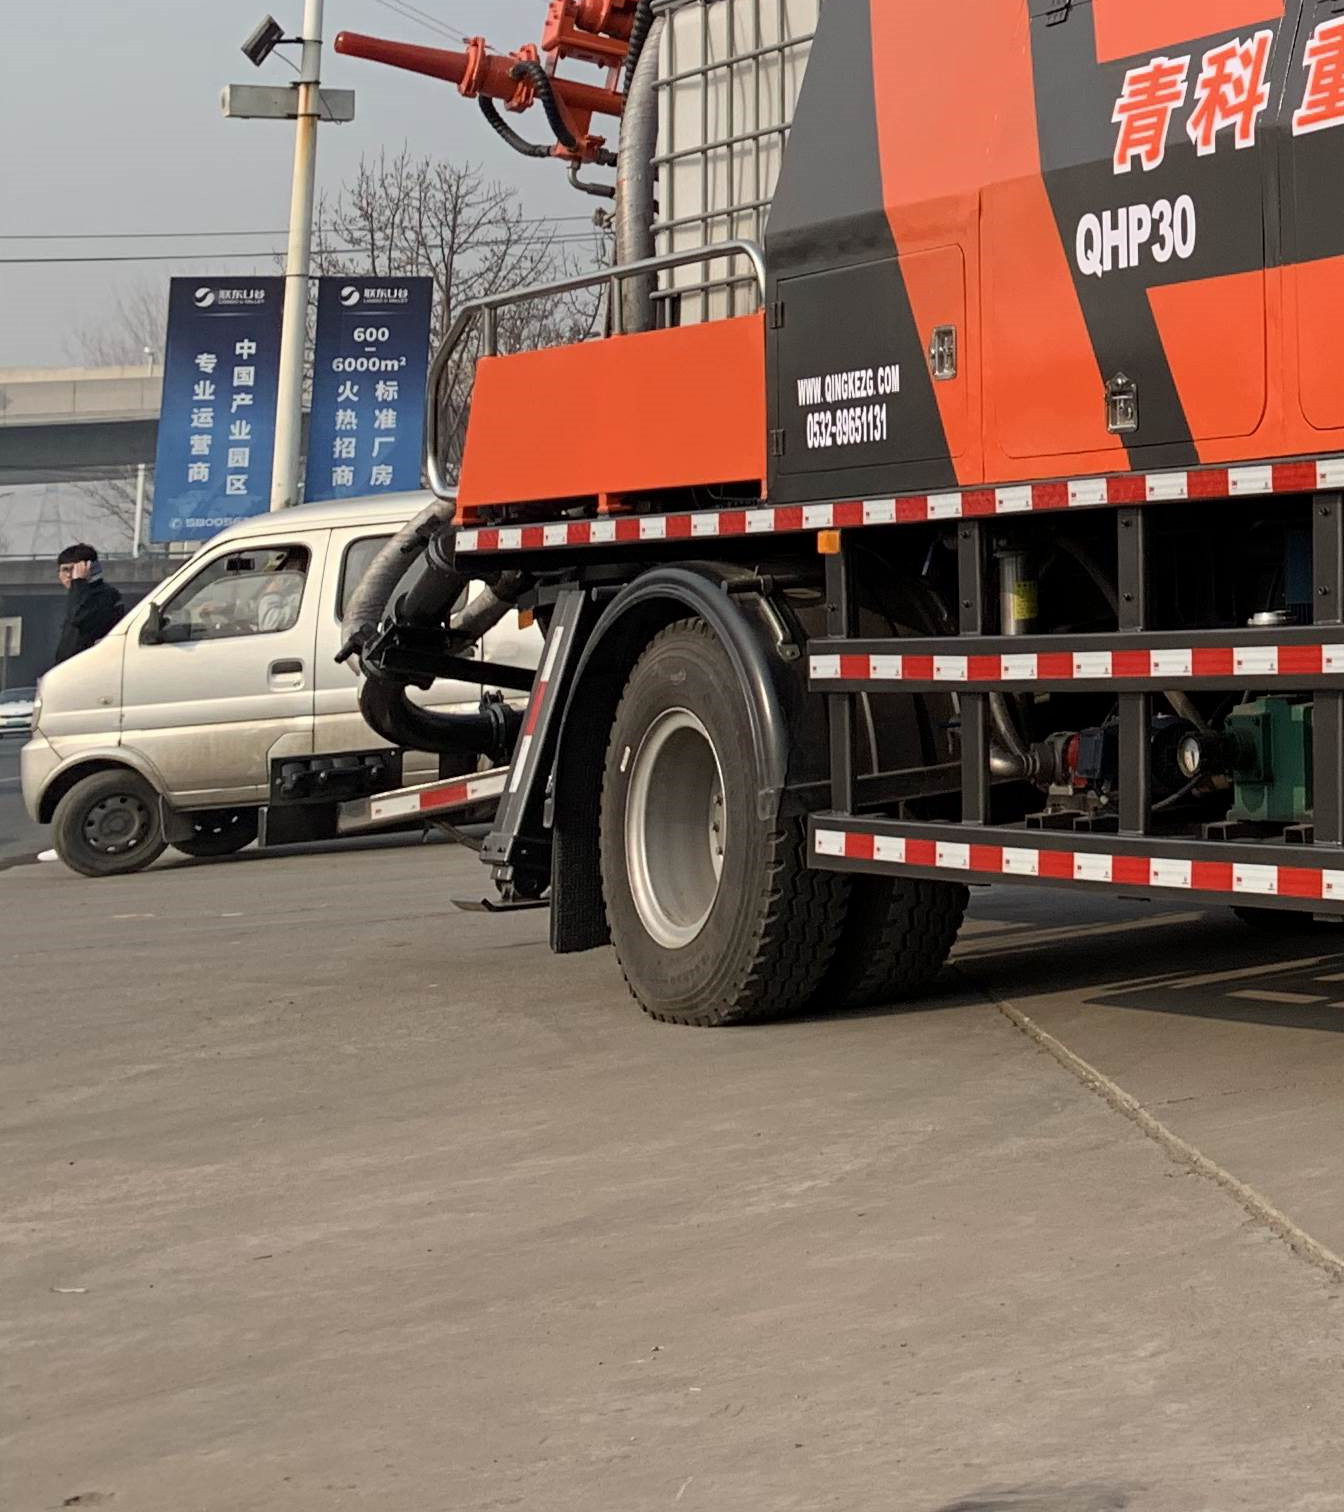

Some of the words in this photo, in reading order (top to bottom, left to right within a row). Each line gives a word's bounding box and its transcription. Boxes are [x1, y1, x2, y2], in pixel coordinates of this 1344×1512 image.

[1075, 194, 1197, 278] QHP30
[353, 327, 390, 342] 600
[187, 352, 217, 483] 专业运营商
[225, 338, 257, 495] 中国产业园区
[331, 381, 360, 486] 火热招商
[369, 380, 399, 486] 标准厂房
[806, 403, 887, 448] 0532-89651131
